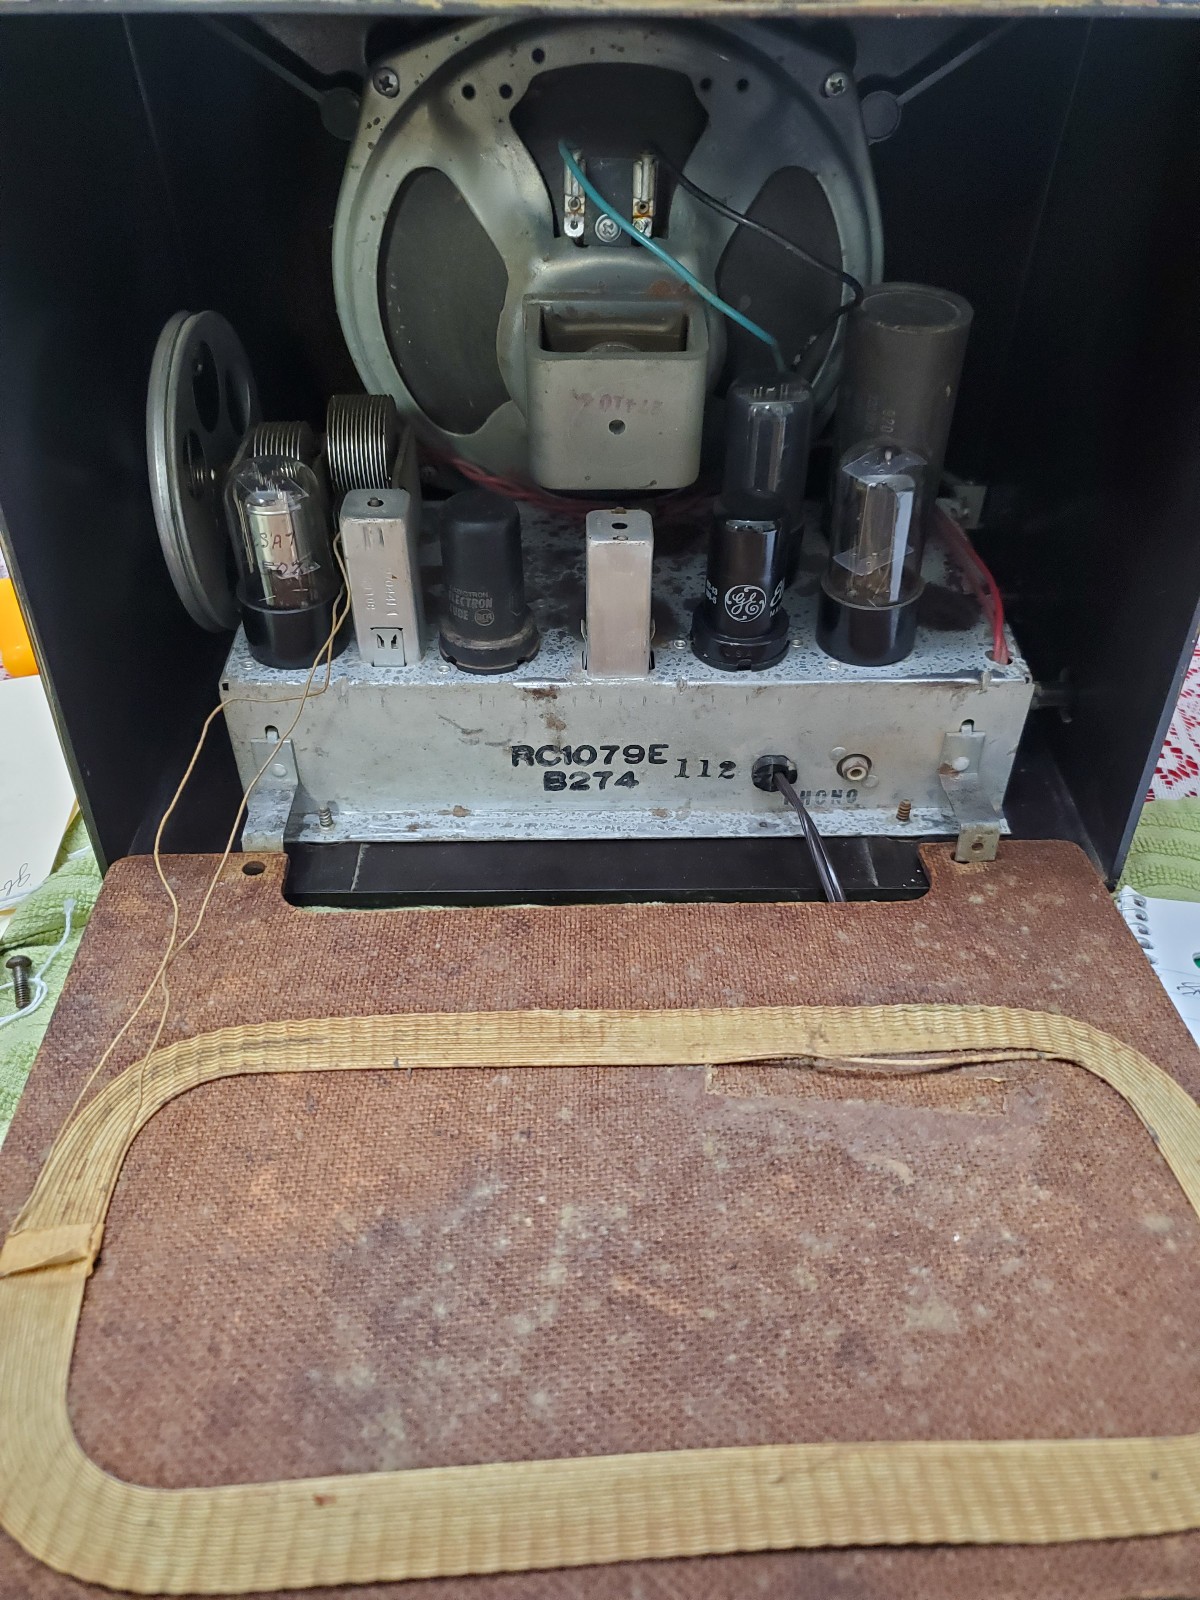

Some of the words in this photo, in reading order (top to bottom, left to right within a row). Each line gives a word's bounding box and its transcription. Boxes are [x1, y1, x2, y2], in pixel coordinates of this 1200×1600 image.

[511, 743, 669, 767] RC1079E
[673, 758, 737, 779] 112
[543, 770, 640, 791] B274
